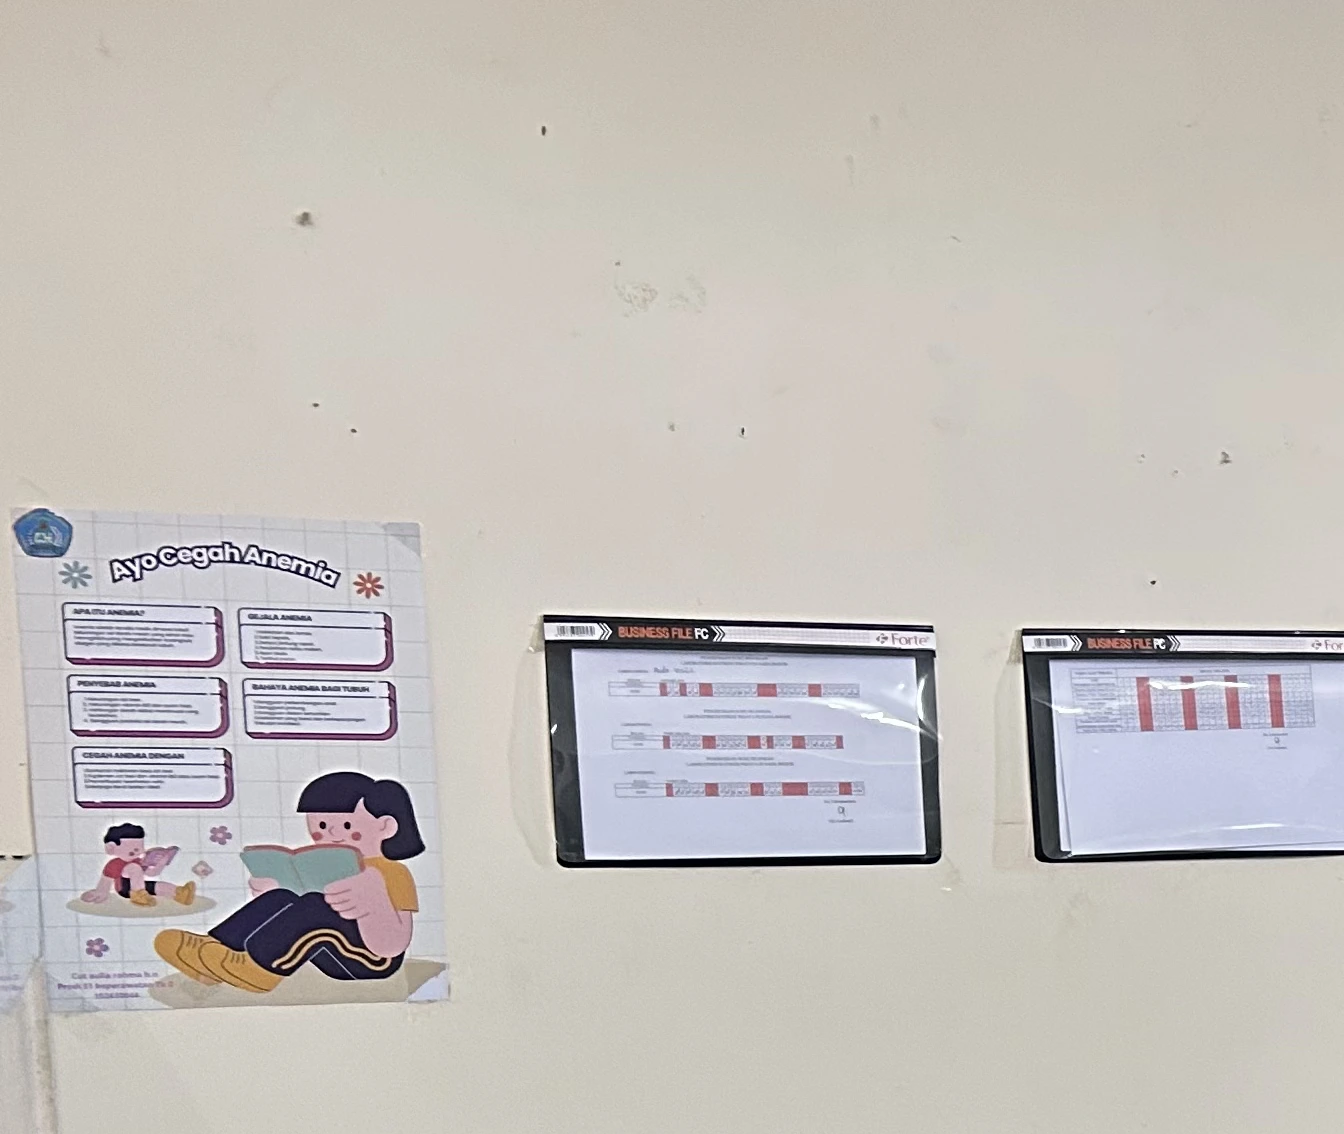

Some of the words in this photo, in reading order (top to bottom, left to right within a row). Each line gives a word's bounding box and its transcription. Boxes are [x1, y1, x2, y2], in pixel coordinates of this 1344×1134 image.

[111, 553, 158, 583] Ayo
[159, 542, 241, 569] Cegah
[243, 545, 340, 588] Anemia
[618, 626, 670, 639] BUSINESS
[672, 627, 693, 639] FILE
[891, 631, 927, 646] Forte
[1087, 638, 1132, 649] BUSINESS
[1133, 638, 1153, 649] FILE
